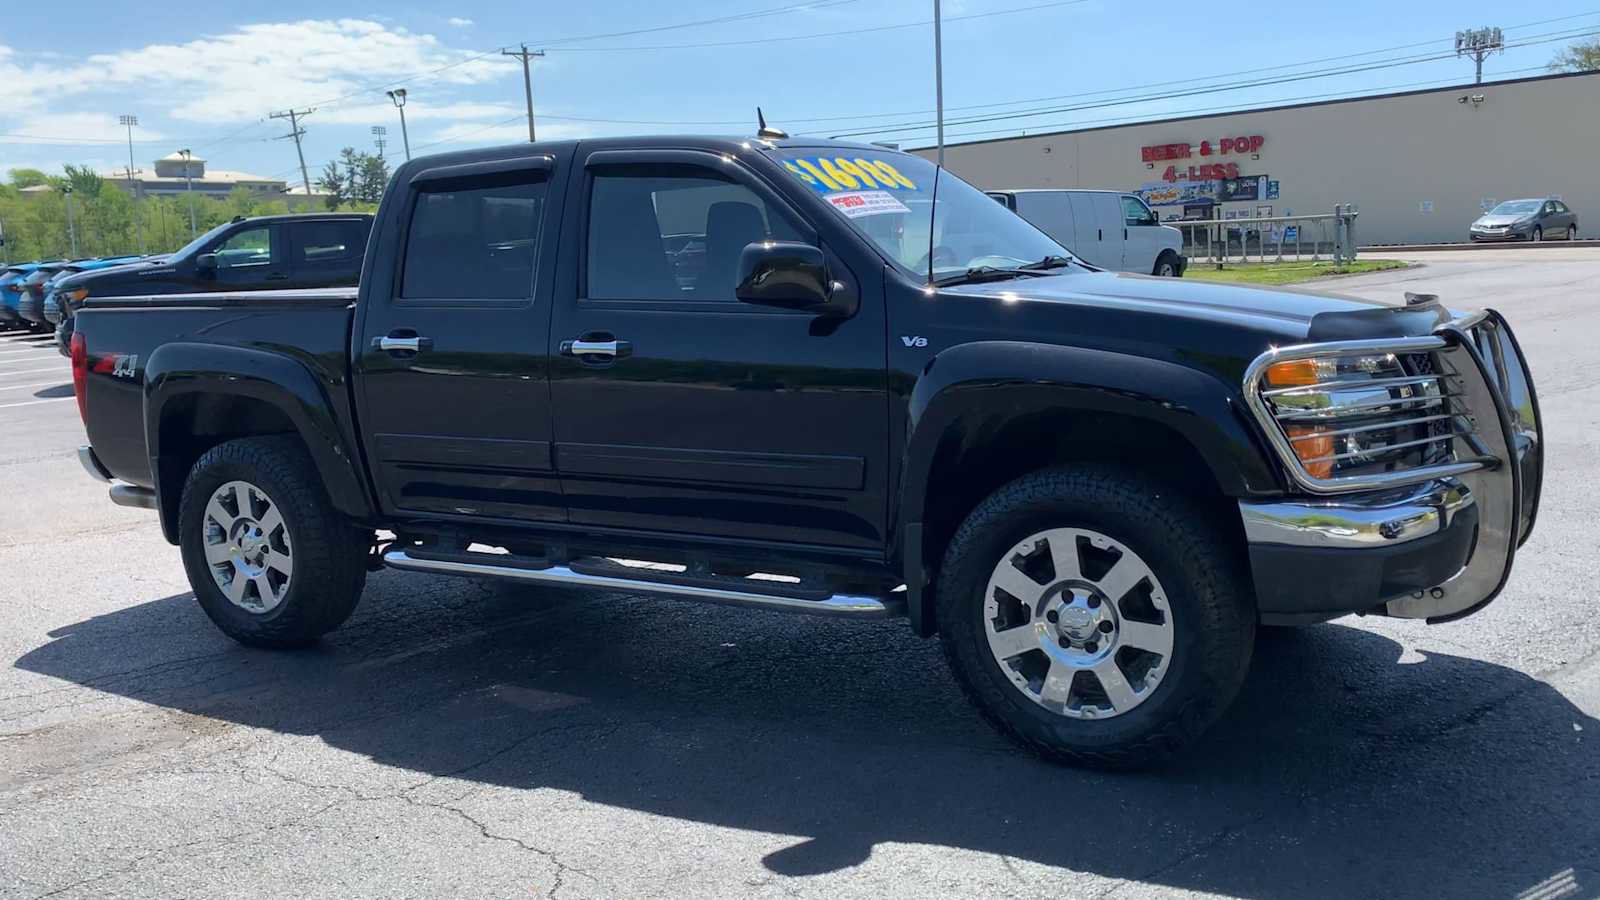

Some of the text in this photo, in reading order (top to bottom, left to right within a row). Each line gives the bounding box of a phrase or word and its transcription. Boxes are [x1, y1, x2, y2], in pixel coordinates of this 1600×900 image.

[1141, 135, 1264, 162] BEER & POP
[783, 157, 917, 191] $16988
[1162, 162, 1240, 183] 4-LESS
[901, 335, 928, 347] V8
